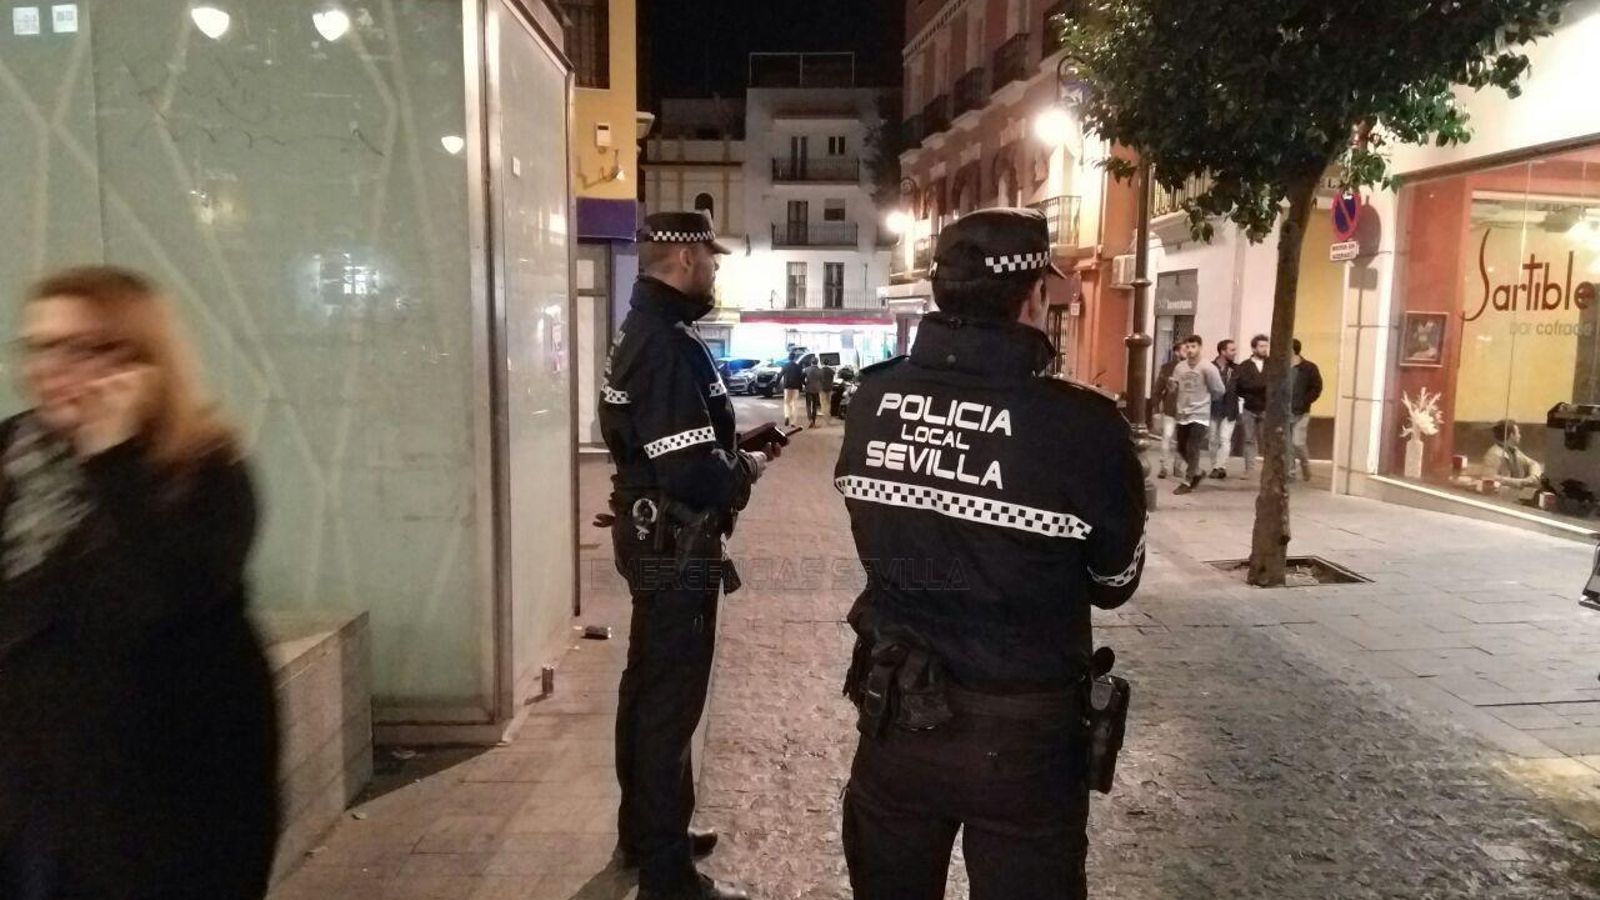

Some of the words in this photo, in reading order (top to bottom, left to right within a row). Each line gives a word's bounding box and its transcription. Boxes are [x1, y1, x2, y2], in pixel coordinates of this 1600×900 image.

[1461, 228, 1597, 322] Sartible
[876, 393, 1012, 437] POLICIA
[901, 424, 970, 450] LOCAL
[866, 441, 1003, 490] SEVILLA
